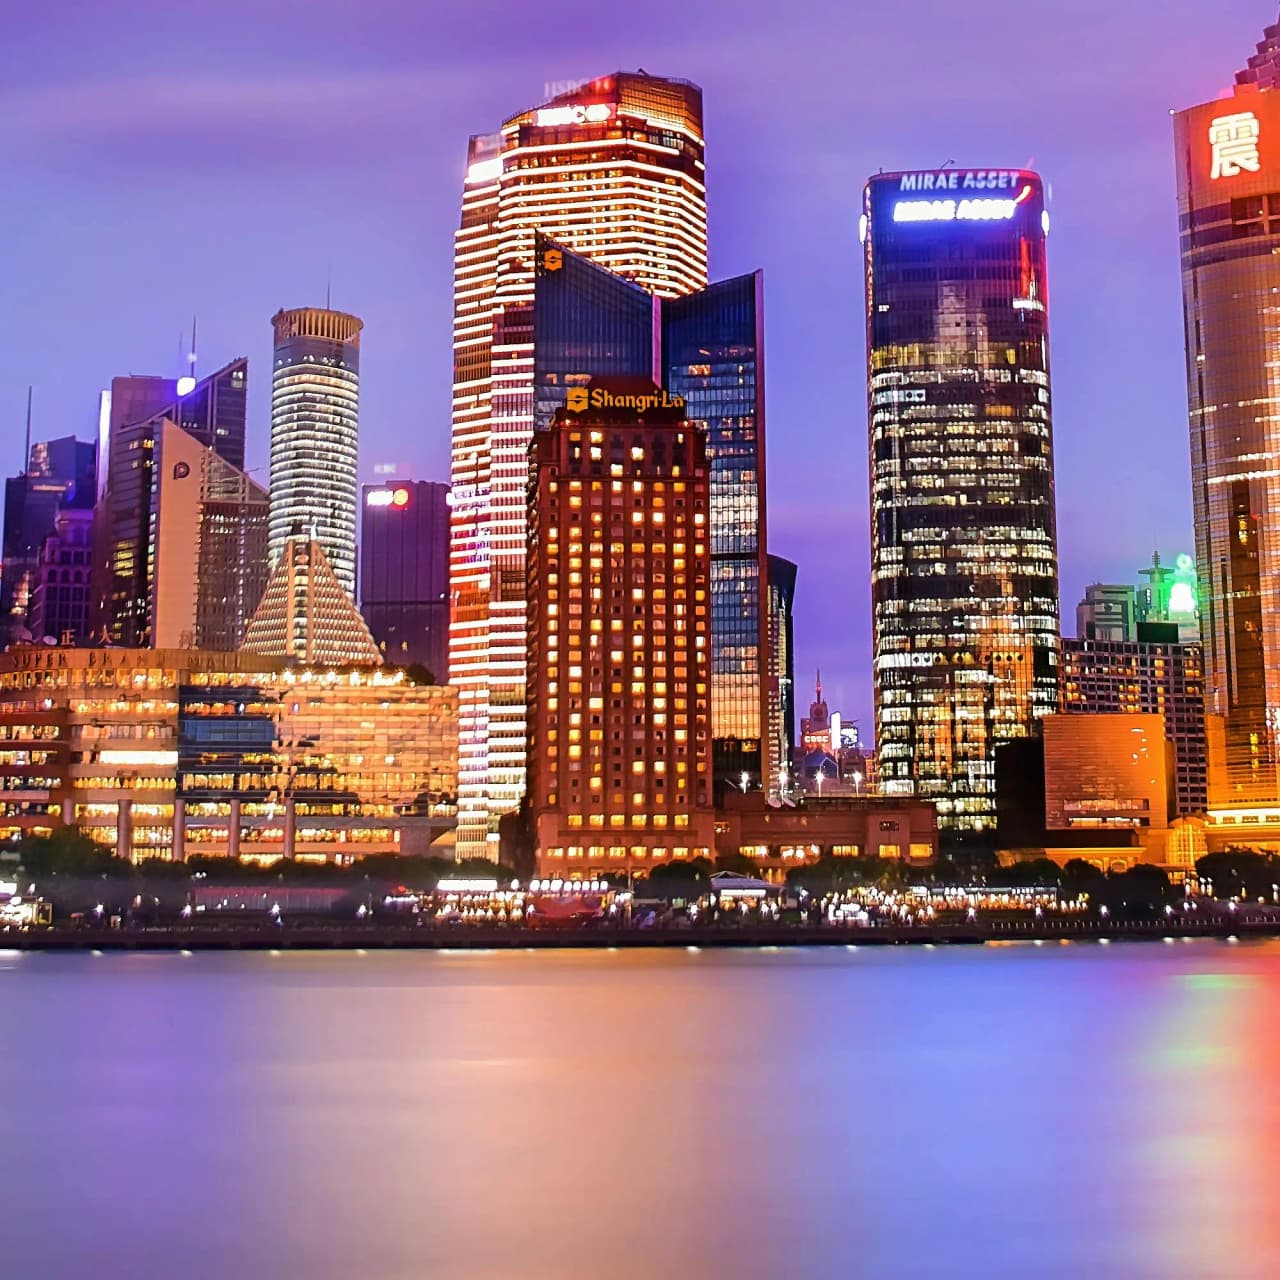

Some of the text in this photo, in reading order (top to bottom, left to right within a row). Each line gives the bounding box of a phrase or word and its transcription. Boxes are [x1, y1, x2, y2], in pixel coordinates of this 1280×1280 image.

[900, 170, 1019, 191] MIRAE ASSET
[13, 651, 68, 669] SUPER
